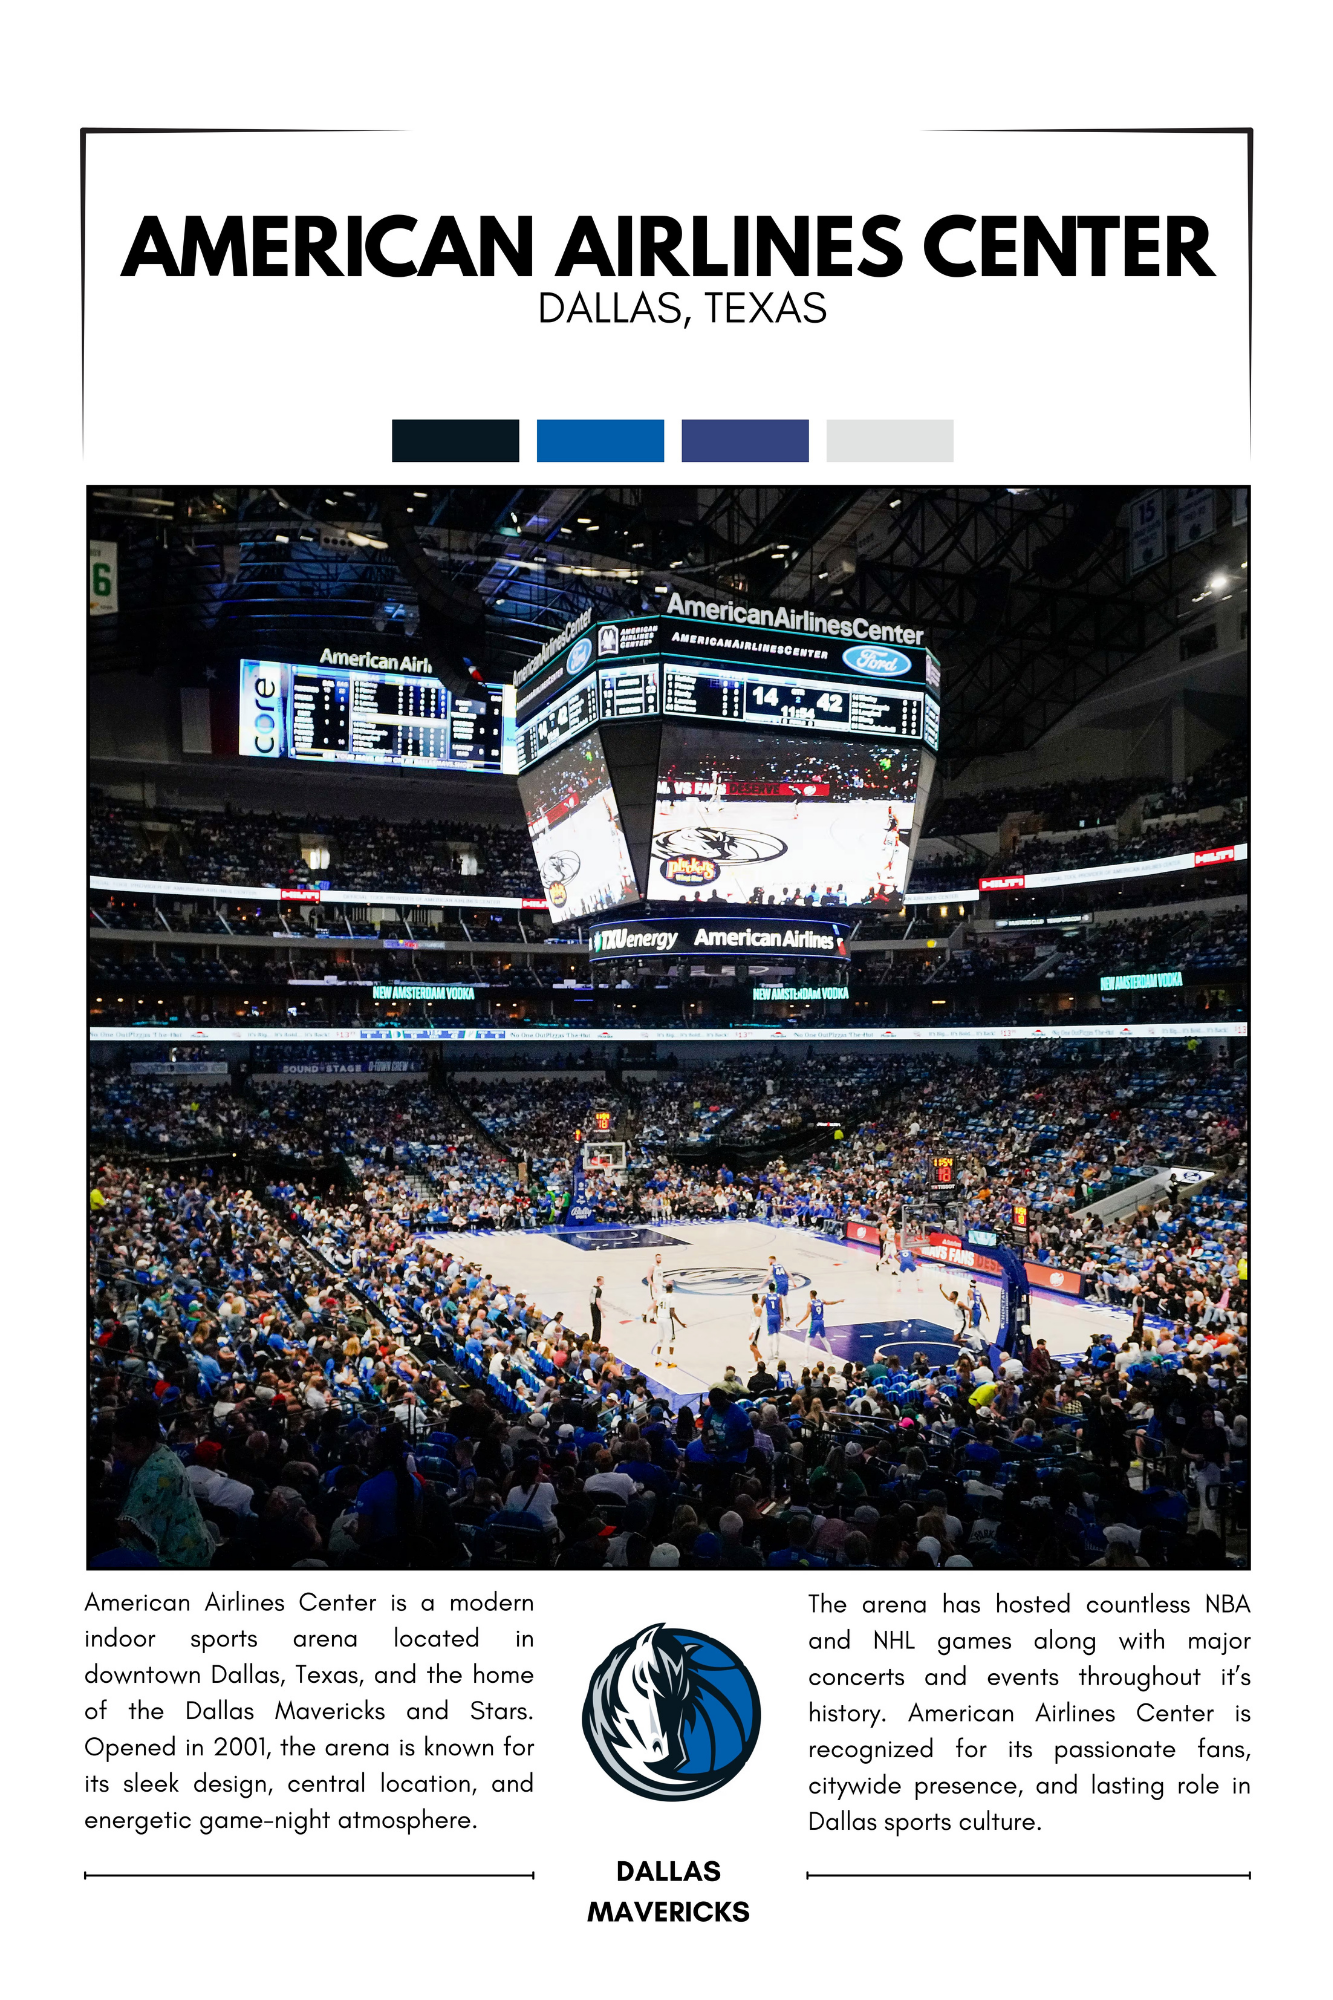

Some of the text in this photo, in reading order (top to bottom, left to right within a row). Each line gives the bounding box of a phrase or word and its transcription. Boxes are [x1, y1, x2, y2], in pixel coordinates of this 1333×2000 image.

[667, 592, 924, 645] AmericanAirlinesCenter
[319, 647, 399, 671] American
[856, 648, 898, 672] Ford
[752, 686, 779, 707] 14
[816, 692, 843, 713] 42
[254, 677, 275, 754] core
[729, 783, 780, 795] DESERVE
[694, 928, 834, 950] American Airlines
[1100, 976, 1115, 991] NEW
[1158, 972, 1183, 987] VODKA
[373, 986, 475, 1000] NEW AMSTERDAM VODKA
[753, 988, 771, 1001] NEW
[821, 987, 849, 1000] VODKA
[283, 1064, 362, 1074] SOUND STAGE
[933, 1158, 953, 1167] 11:54
[949, 1247, 975, 1266] FANS
